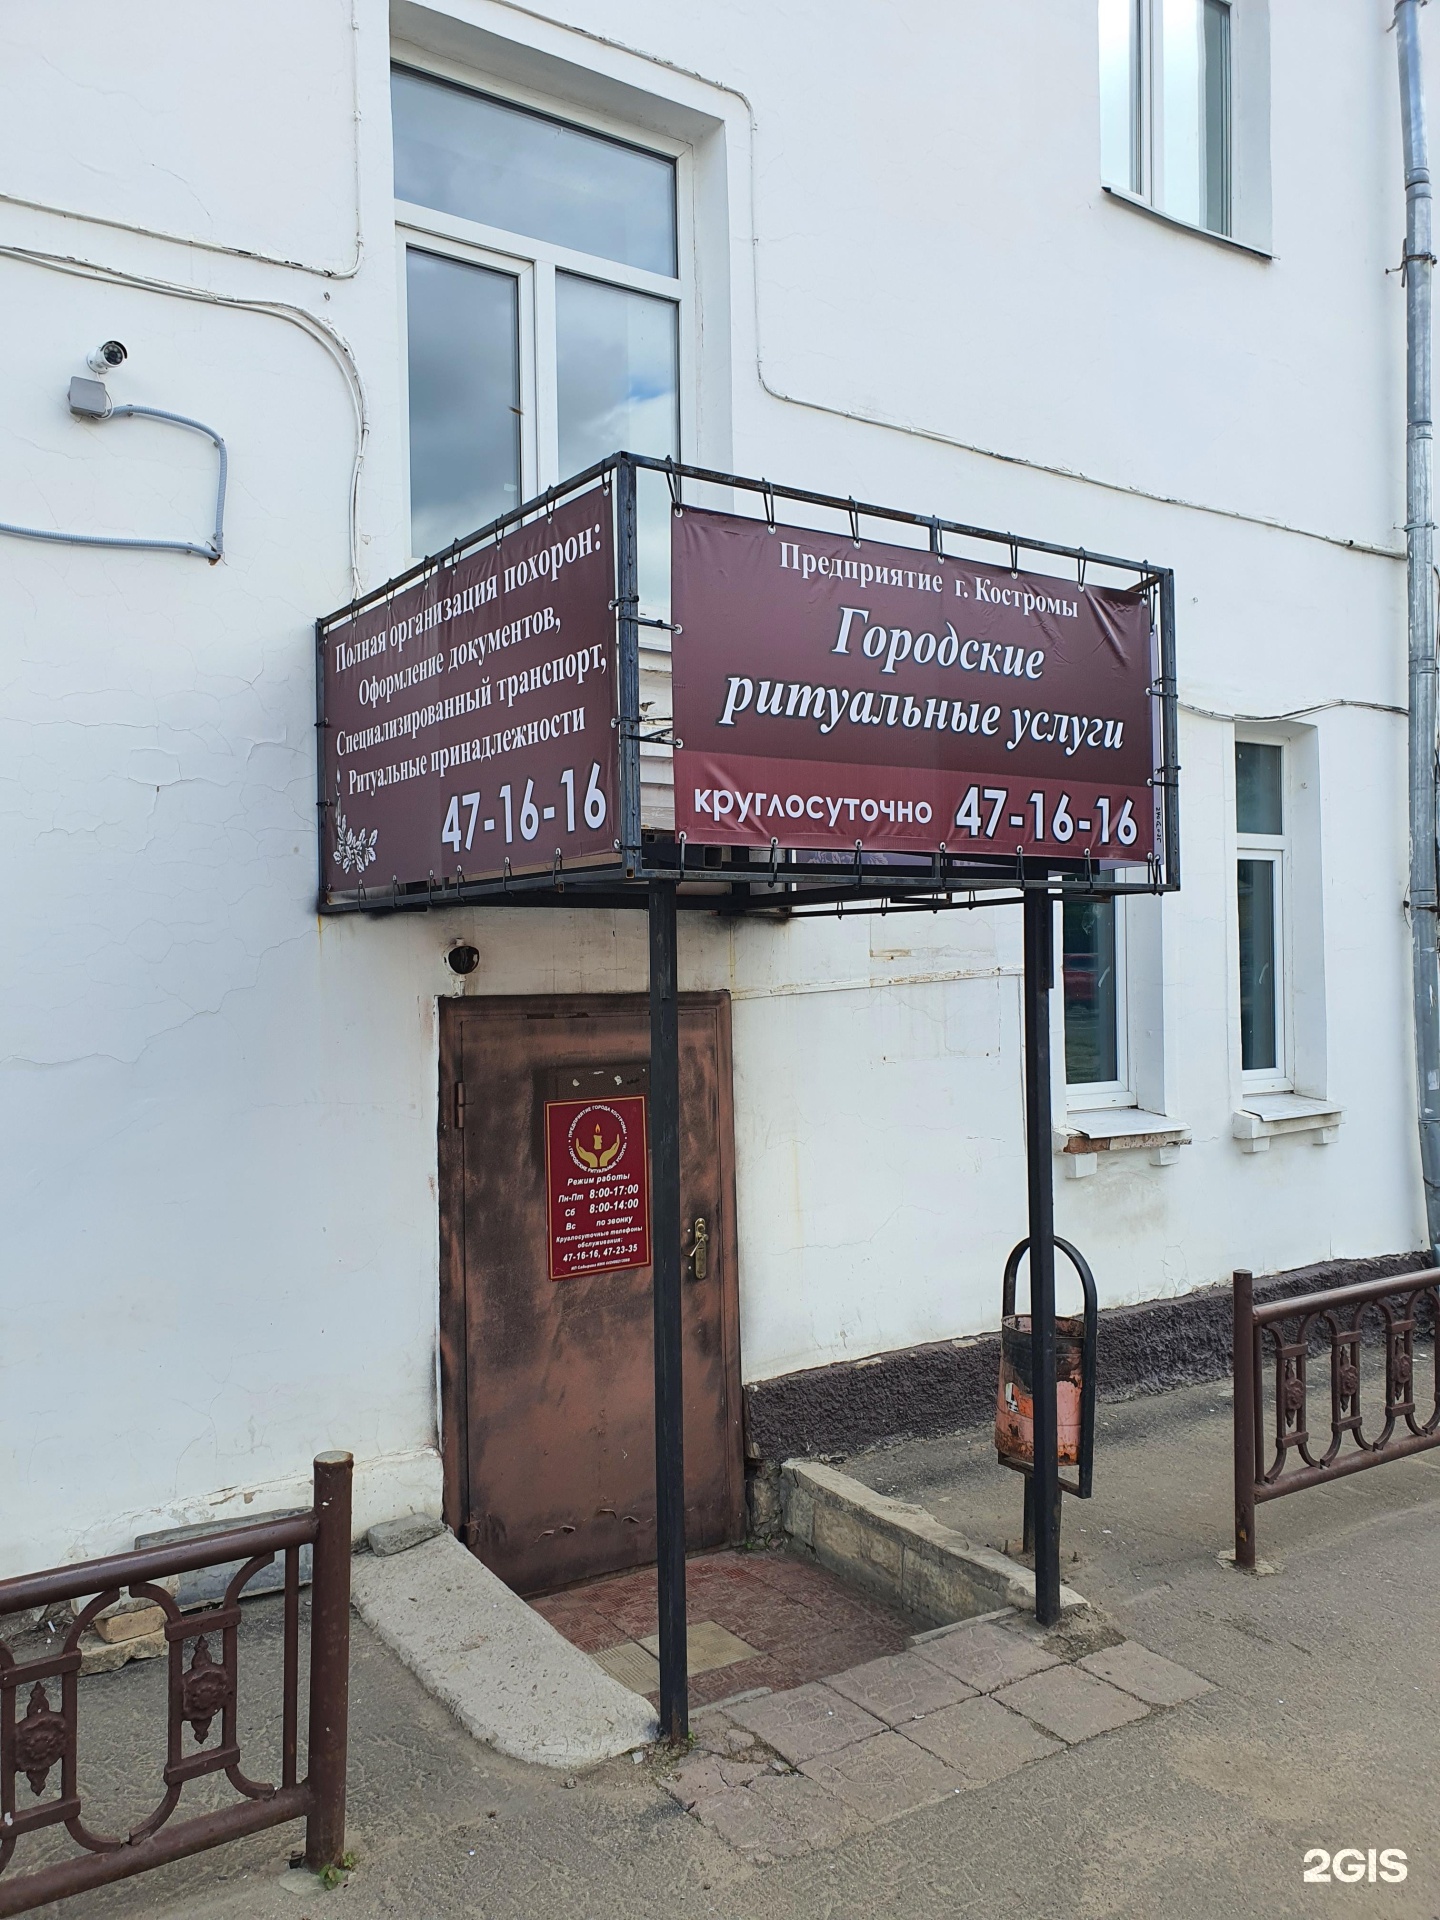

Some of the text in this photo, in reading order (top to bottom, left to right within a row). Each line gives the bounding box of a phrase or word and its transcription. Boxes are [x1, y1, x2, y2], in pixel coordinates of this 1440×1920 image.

[336, 523, 601, 673] Полная организация похорон:
[779, 541, 1078, 618] Предприятие г. Костромы
[359, 606, 561, 708] Оформление документов,
[831, 606, 1045, 680] Городские
[336, 643, 607, 756] Специализированный транспорт,
[719, 675, 1124, 756] ритуальные услуги
[349, 707, 586, 796] Ритуальные принадлежности
[441, 762, 607, 853] 47-16-16
[694, 787, 932, 827] круглосуточно
[955, 786, 1138, 846] 47-16-16
[610, 1109, 627, 1134] КОСТРОМЫ
[558, 1184, 639, 1203] Пн-Пт 8:00-17:00
[565, 1199, 639, 1217] Сб 8:00-14:00
[567, 1173, 630, 1186] Режим работы
[556, 1226, 642, 1243] Круглосуточные телефоны
[563, 1244, 638, 1262] 47-16-16, 47-23-35
[566, 1216, 633, 1231] Вс по звонку
